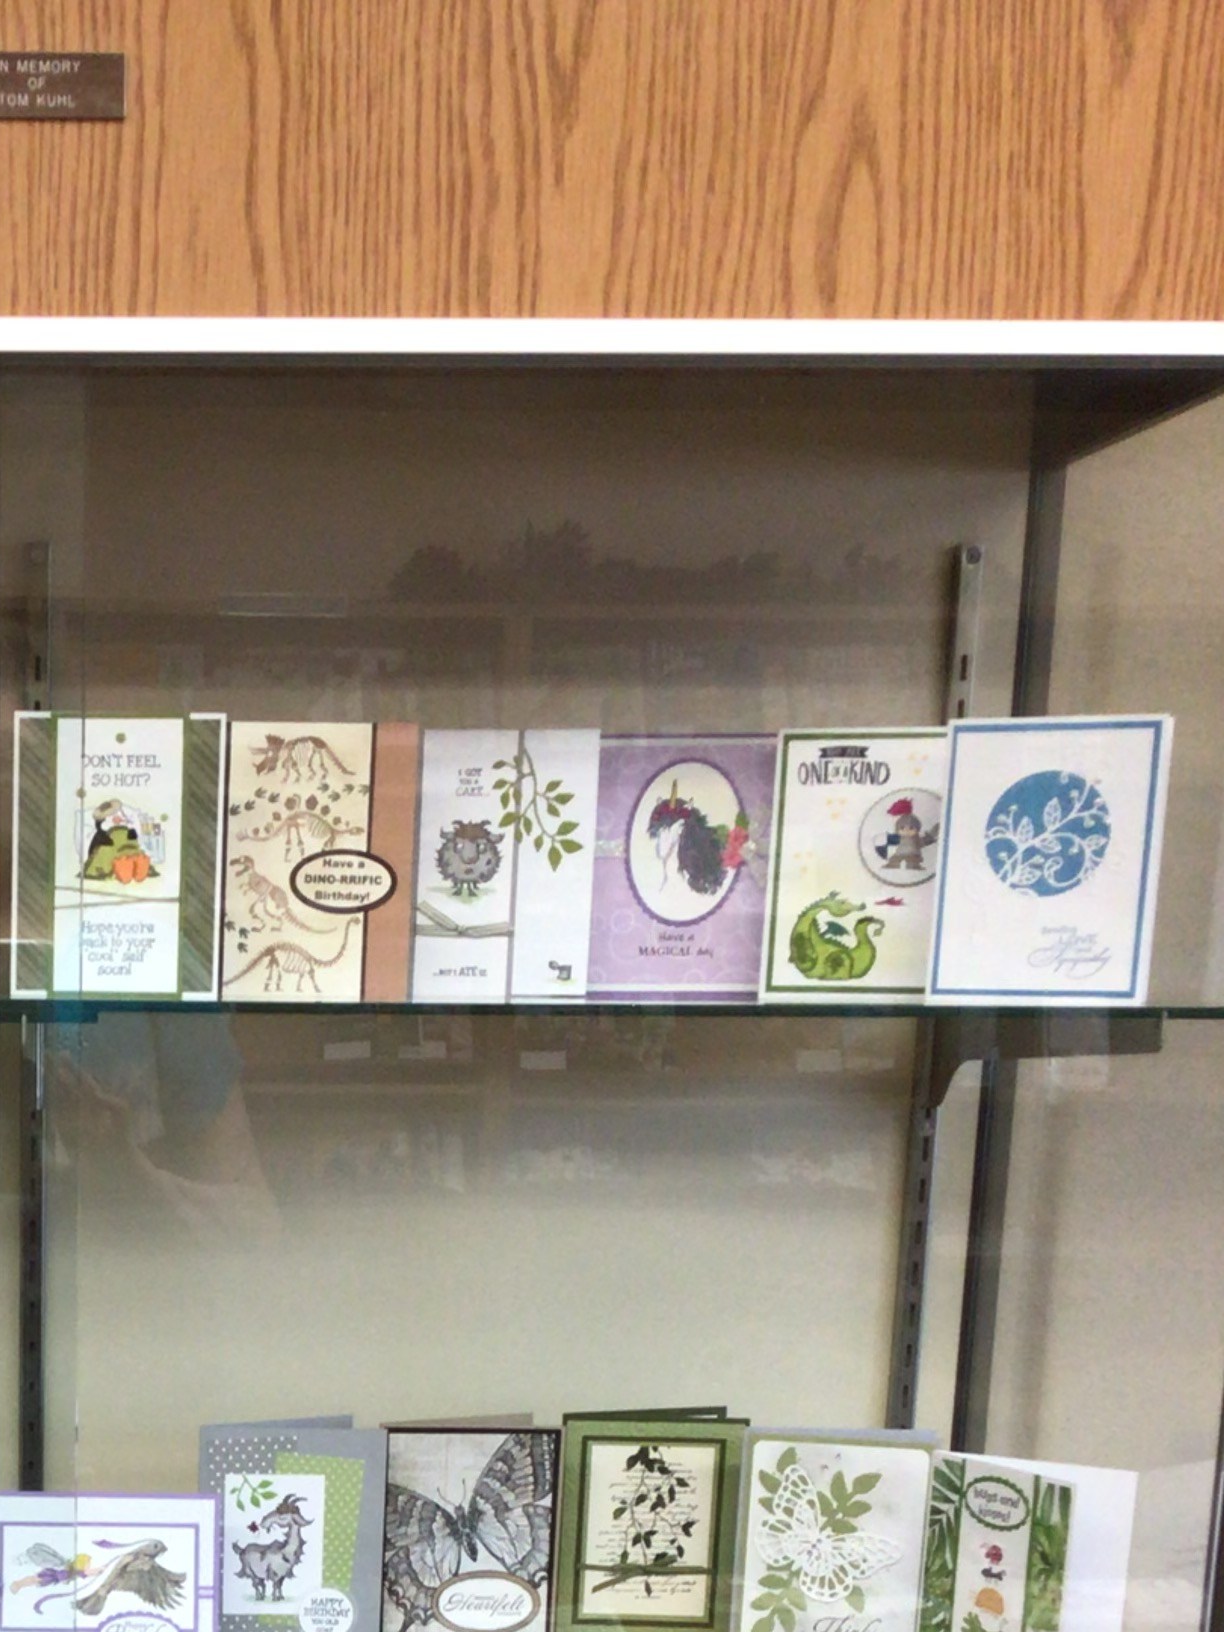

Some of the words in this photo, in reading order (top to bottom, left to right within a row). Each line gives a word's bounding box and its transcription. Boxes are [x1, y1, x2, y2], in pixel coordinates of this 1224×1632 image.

[17, 60, 81, 73] MEMORY
[27, 77, 46, 90] OF
[36, 94, 75, 108] KUHL
[126, 754, 161, 768] FEEL
[91, 773, 111, 787] SO
[114, 772, 151, 787] HOT?
[798, 761, 833, 786] ONE
[849, 760, 890, 786] KIND
[323, 859, 353, 868] Have
[357, 860, 365, 868] a
[304, 874, 383, 885] DINO-RRIFIC
[314, 890, 370, 903] Birthday!
[311, 1598, 344, 1607] HAPPY
[443, 1592, 526, 1617] Heartfelt
